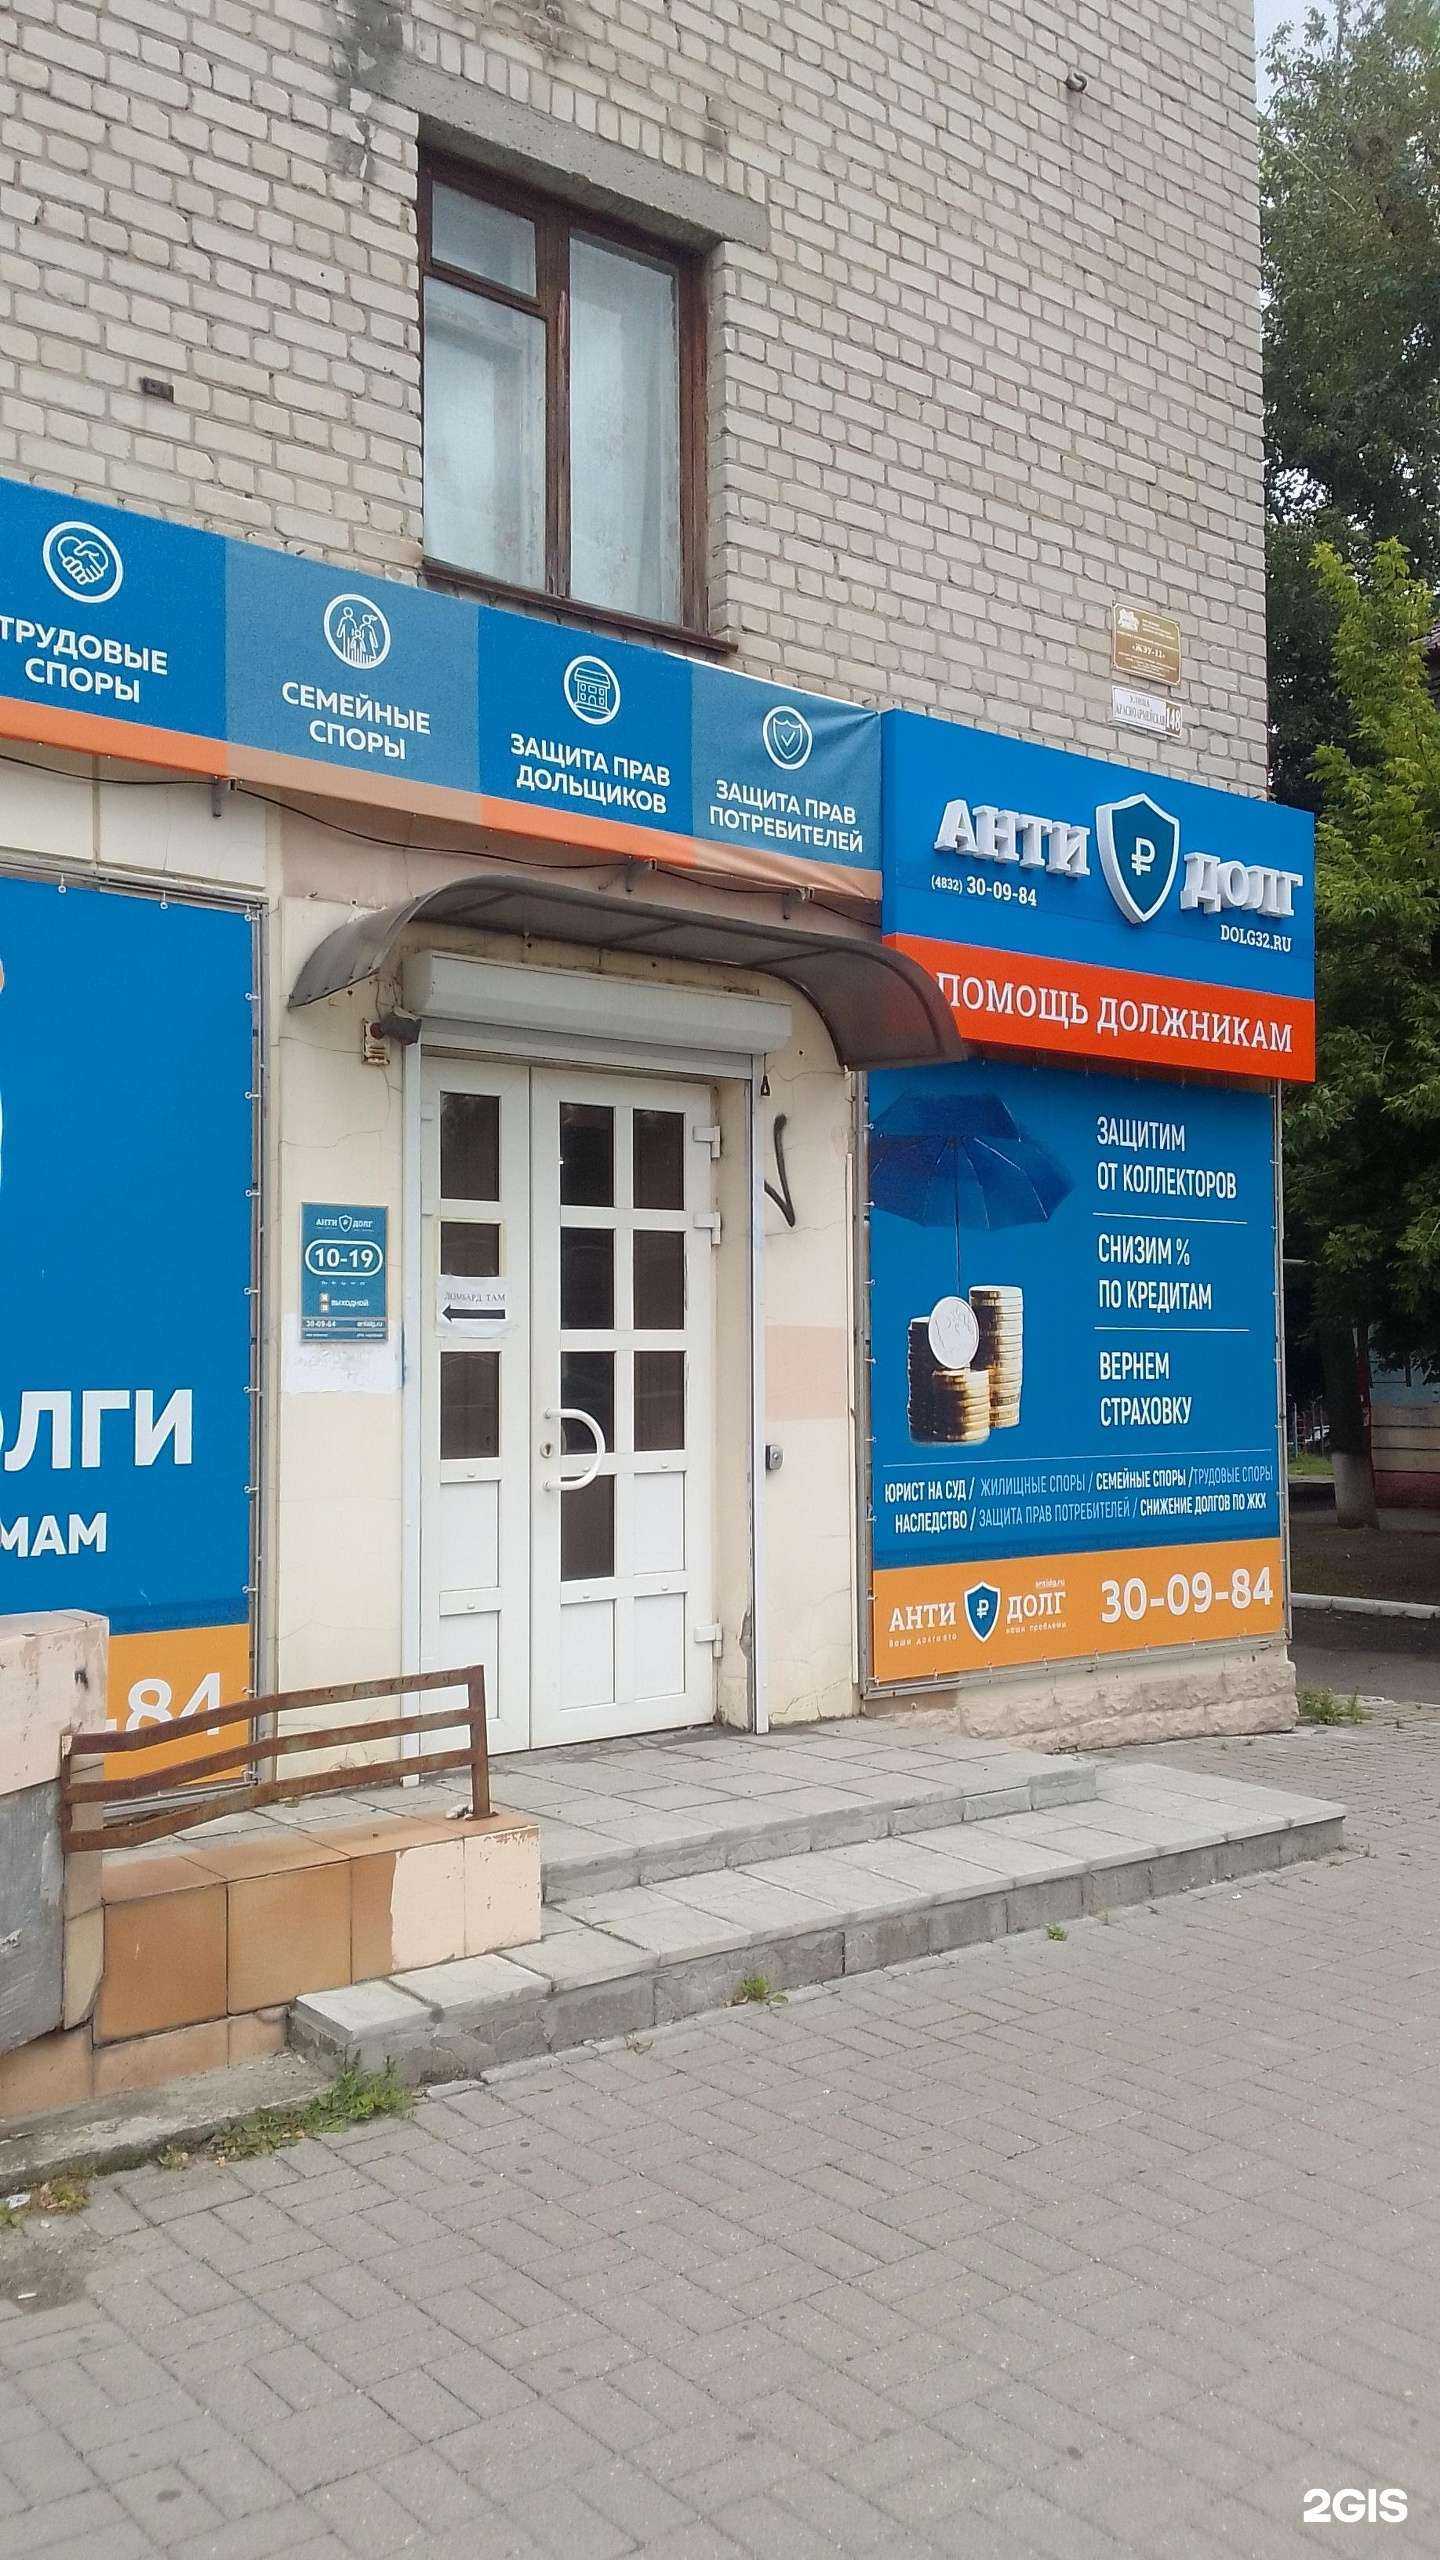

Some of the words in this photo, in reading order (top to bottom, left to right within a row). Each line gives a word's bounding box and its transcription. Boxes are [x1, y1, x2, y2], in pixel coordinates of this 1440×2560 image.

[0, 615, 168, 676] ТРУДОВЫЕ
[24, 658, 140, 703] СПОРЫ
[281, 681, 430, 735] СЕМЕЙНЫЕ
[1166, 707, 1181, 731] 148
[309, 720, 406, 760] СПОРЫ
[510, 733, 609, 774] ЗАЩИТА
[613, 756, 671, 787] ПРАВ
[516, 765, 667, 814] ДОЛЬЩИКОВ
[716, 780, 801, 816] ЗАЩИТА
[804, 800, 856, 825] ПРАВ
[709, 805, 863, 853] ПОТРЕБИТЕЛЕЙ
[933, 798, 1091, 878] АНТИ
[1180, 852, 1304, 919] ДОЛГ
[931, 874, 963, 895] (4832)
[966, 876, 1038, 906] 30-09-84
[1220, 924, 1292, 952] DOLG32.RU
[936, 972, 1089, 1030] ПОМОЩЬ
[1097, 997, 1293, 1053] ДОЛЖНИКАМ
[1097, 1116, 1185, 1151] ЗАЩИТИМ
[1098, 1161, 1118, 1190] ОТ
[1123, 1164, 1237, 1199] КОЛЛЕКТОРОВ
[315, 1248, 373, 1268] 10-19
[1099, 1234, 1171, 1264] СНИЗИМ
[1176, 1238, 1190, 1265] %
[484, 1293, 506, 1303] ТАМ
[1099, 1280, 1121, 1308] ПО
[1127, 1281, 1212, 1313] КРЕДИТАМ
[1100, 1352, 1170, 1380] ВЕРНЕМ
[0, 1389, 193, 1471] ЛГИ
[1100, 1397, 1192, 1426] СТРАХОВКУ
[885, 1483, 925, 1503] ЮРИСТ
[928, 1482, 943, 1500] НА
[946, 1480, 966, 1501] СУД
[981, 1475, 1047, 1497] ЖИЛИЩНЫЕ
[1050, 1473, 1085, 1492] СПОРЫ
[1096, 1467, 1151, 1490] СЕМЕЙНЫЕ
[1153, 1468, 1186, 1487] СПОРЫ
[1242, 1465, 1273, 1483] СПОРЫ
[895, 1510, 967, 1533] НАСЛЕДСТВО
[979, 1507, 1023, 1528] ЗАЩИТА
[1025, 1504, 1052, 1523] ПРАВ
[1054, 1497, 1130, 1522] ПОТРЕБИТЕЛЕЙ
[1140, 1496, 1193, 1516] СНИЖЕНИЕ
[1195, 1494, 1230, 1515] ДОЛГОВ
[1232, 1493, 1245, 1510] ПО
[1247, 1492, 1266, 1509] ЖКХ
[889, 1602, 957, 1632] АНТИ
[1007, 1591, 1067, 1624] ДОЛГ
[1101, 1567, 1273, 1623] 30-09-84
